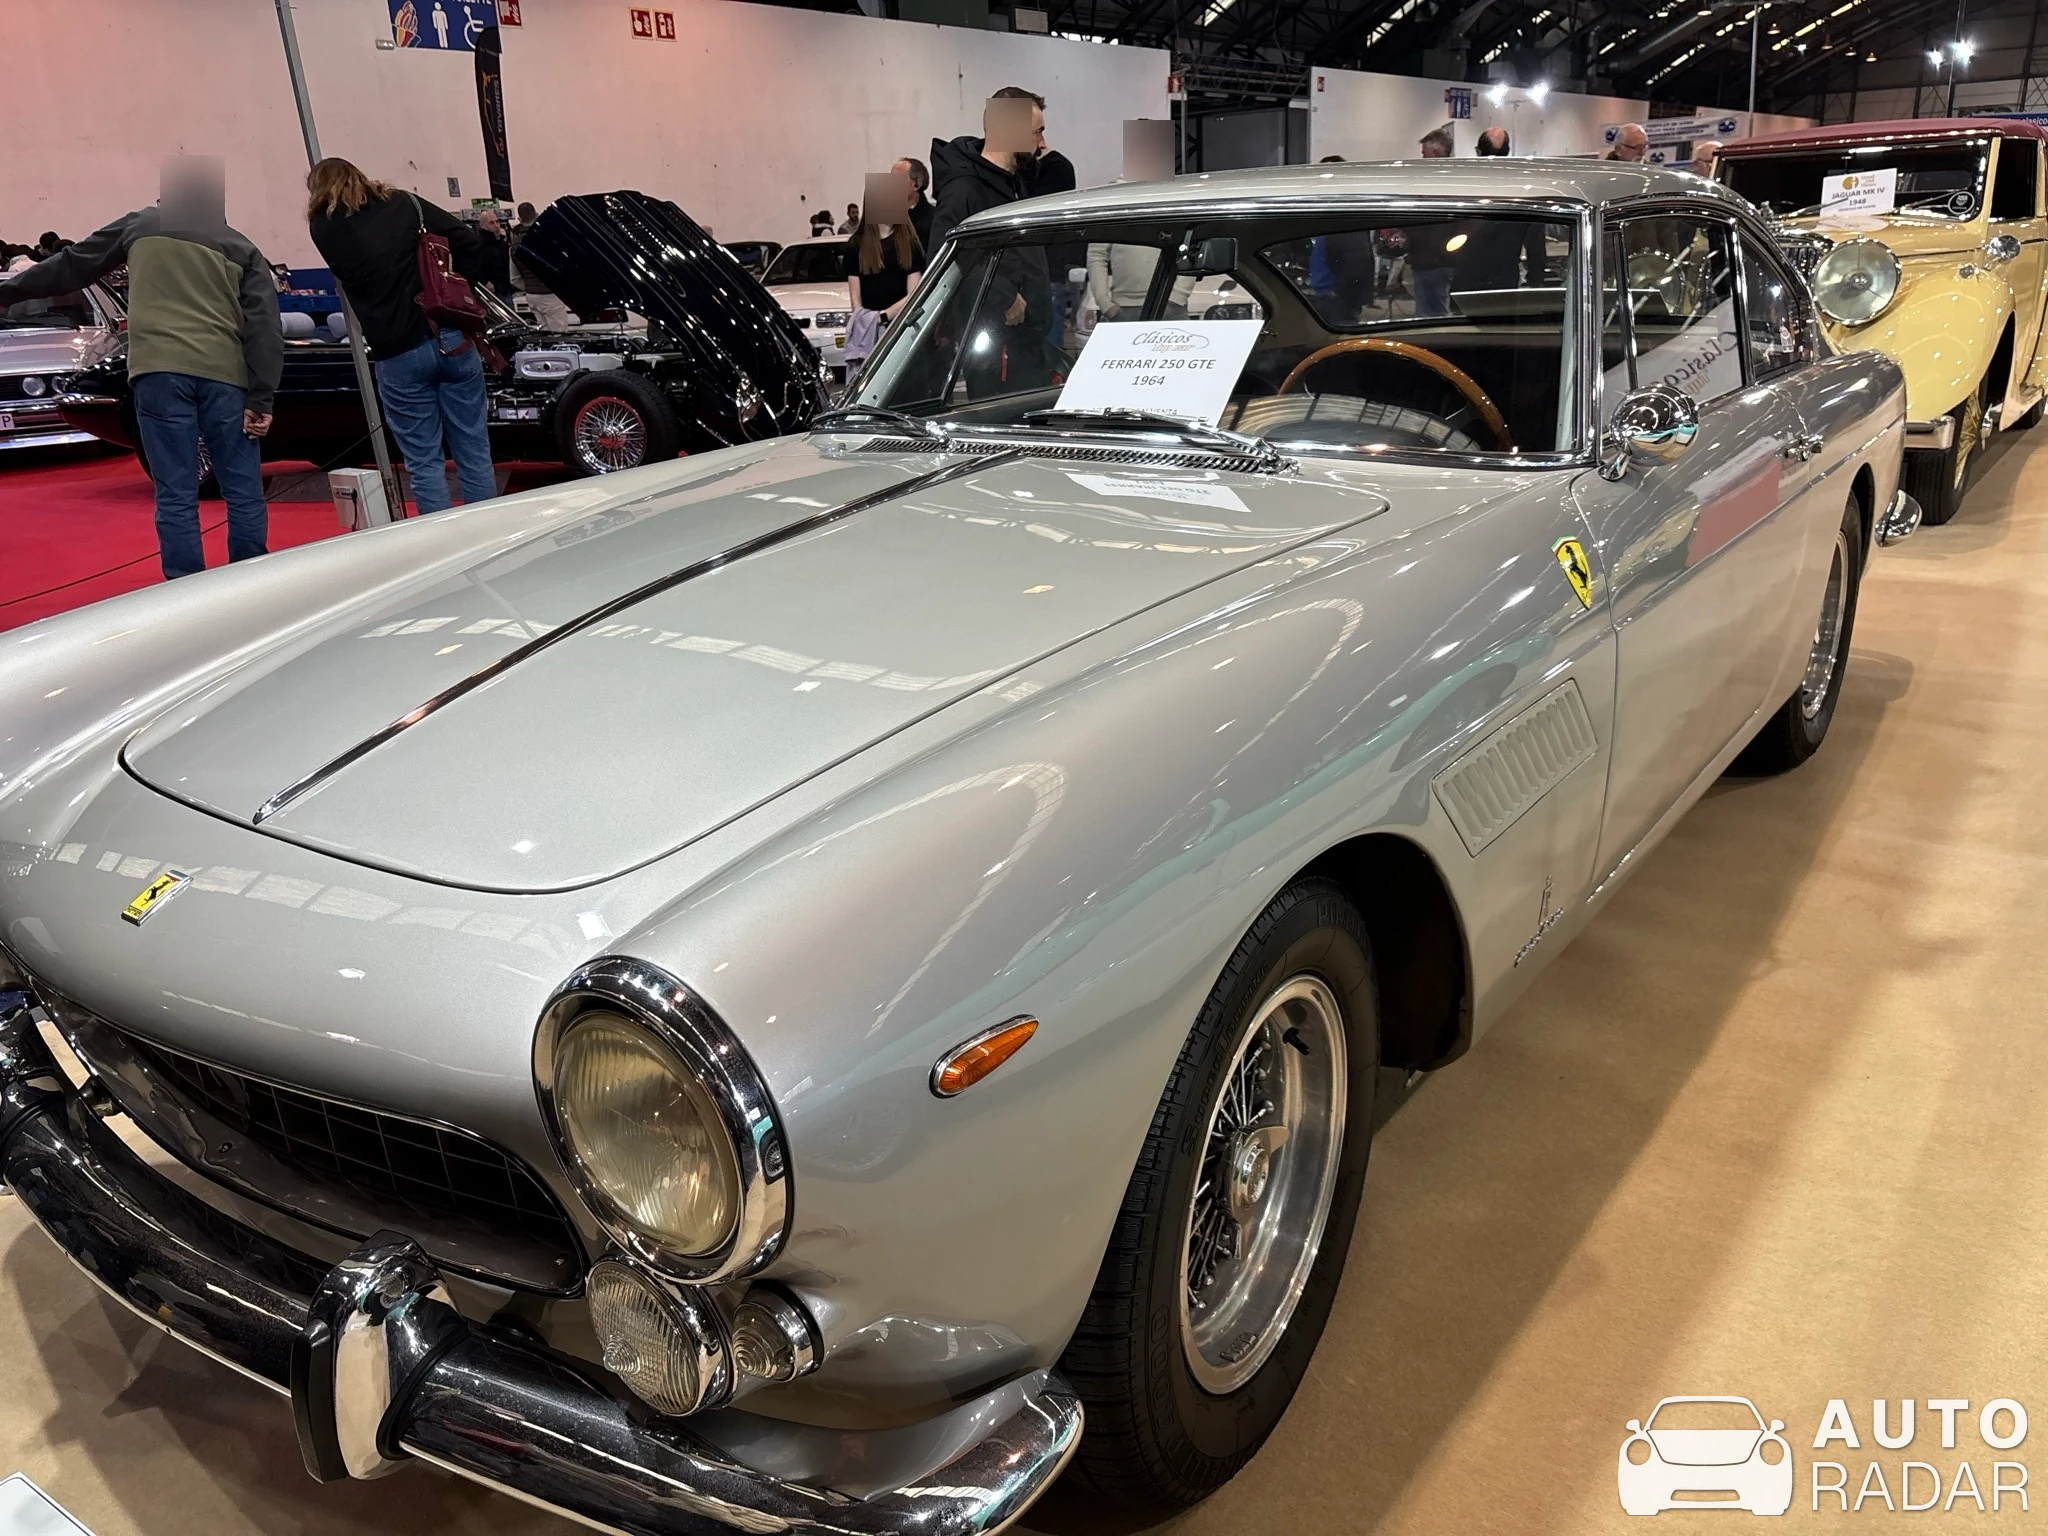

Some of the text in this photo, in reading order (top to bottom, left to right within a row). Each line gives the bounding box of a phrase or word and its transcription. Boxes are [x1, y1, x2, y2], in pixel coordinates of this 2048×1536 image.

[1831, 190, 1861, 199] JAGUAR
[1849, 198, 1867, 206] 1948
[1132, 331, 1193, 345] Clásicos
[1101, 359, 1216, 369] FERRARI 250 GTE
[1131, 375, 1166, 386] 1964
